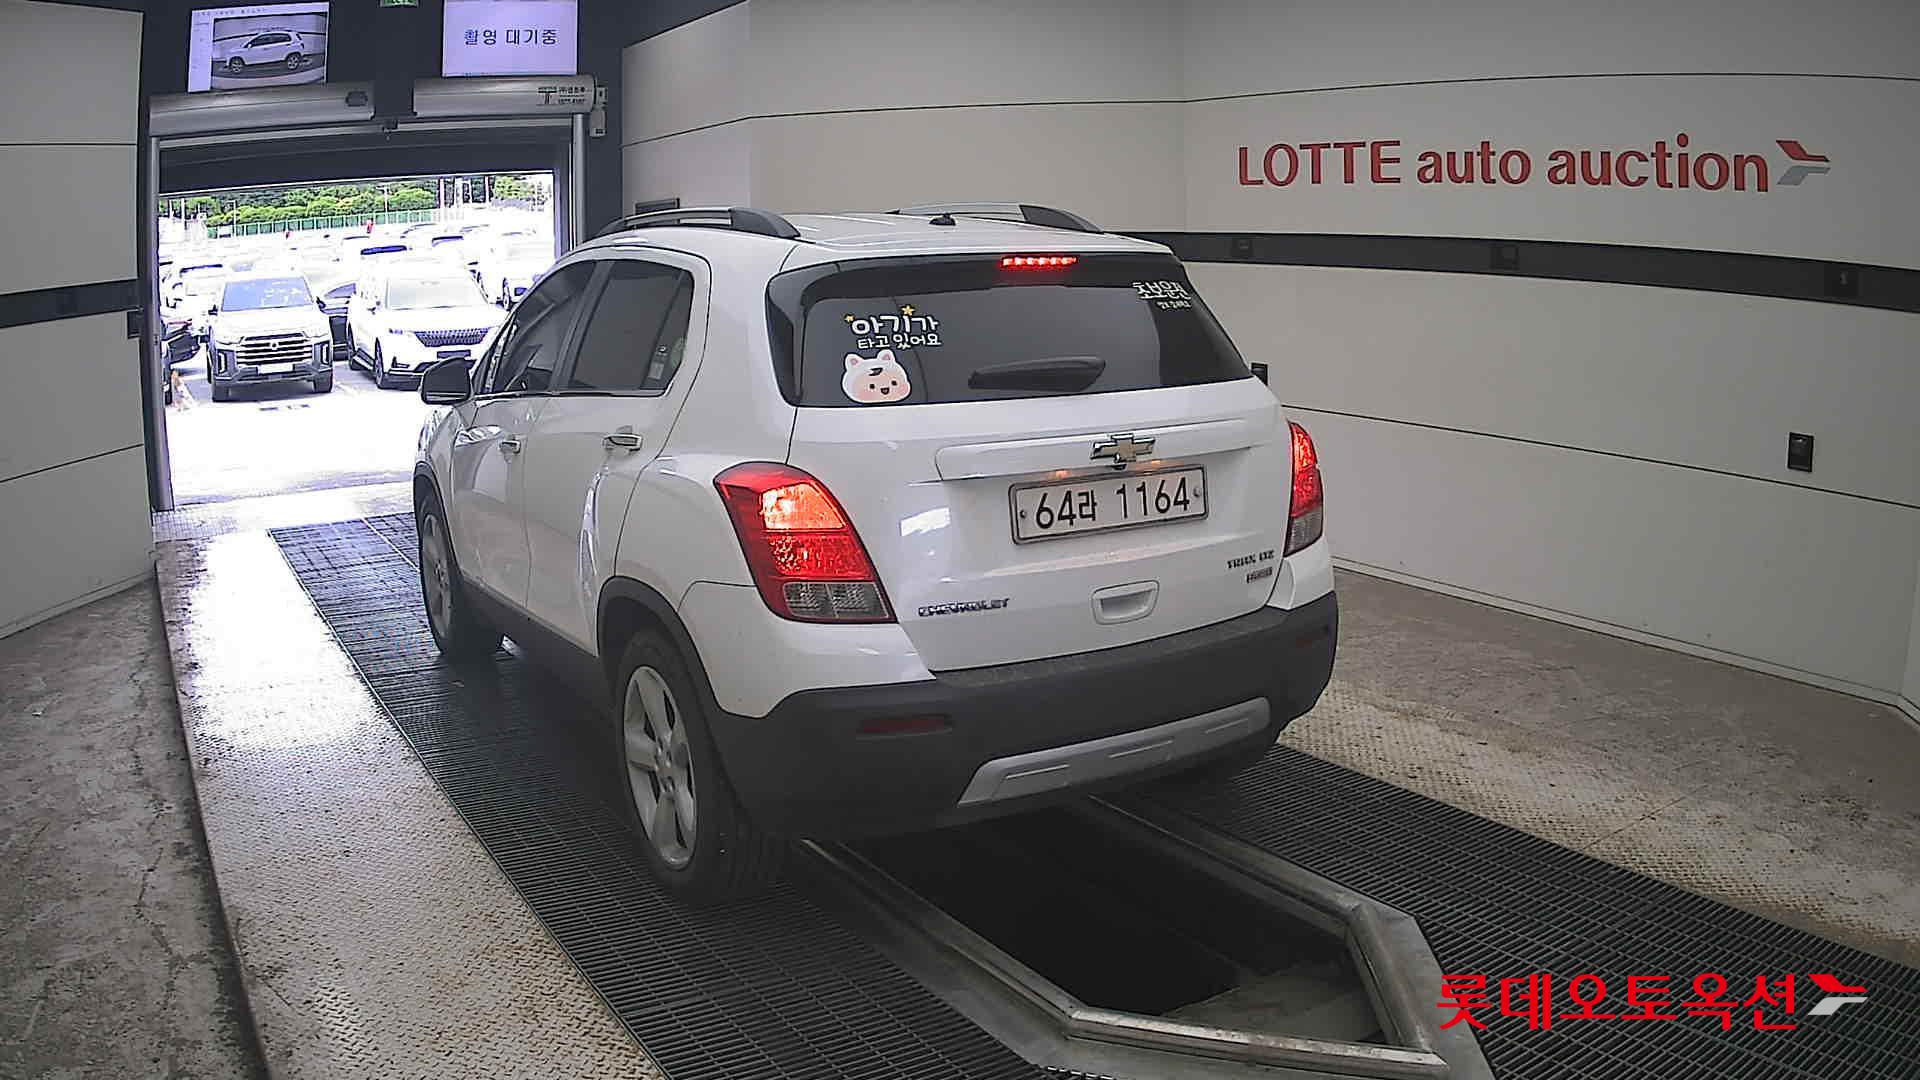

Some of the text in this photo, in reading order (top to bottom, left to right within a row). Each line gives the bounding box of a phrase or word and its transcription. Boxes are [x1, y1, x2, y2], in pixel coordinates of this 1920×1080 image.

[505, 29, 557, 45] 대기중
[1239, 133, 1769, 193] LOTTE auto auction
[851, 315, 939, 335] 아기가
[857, 333, 942, 350] 타고 있어요
[1035, 477, 1190, 529] 64라 1164
